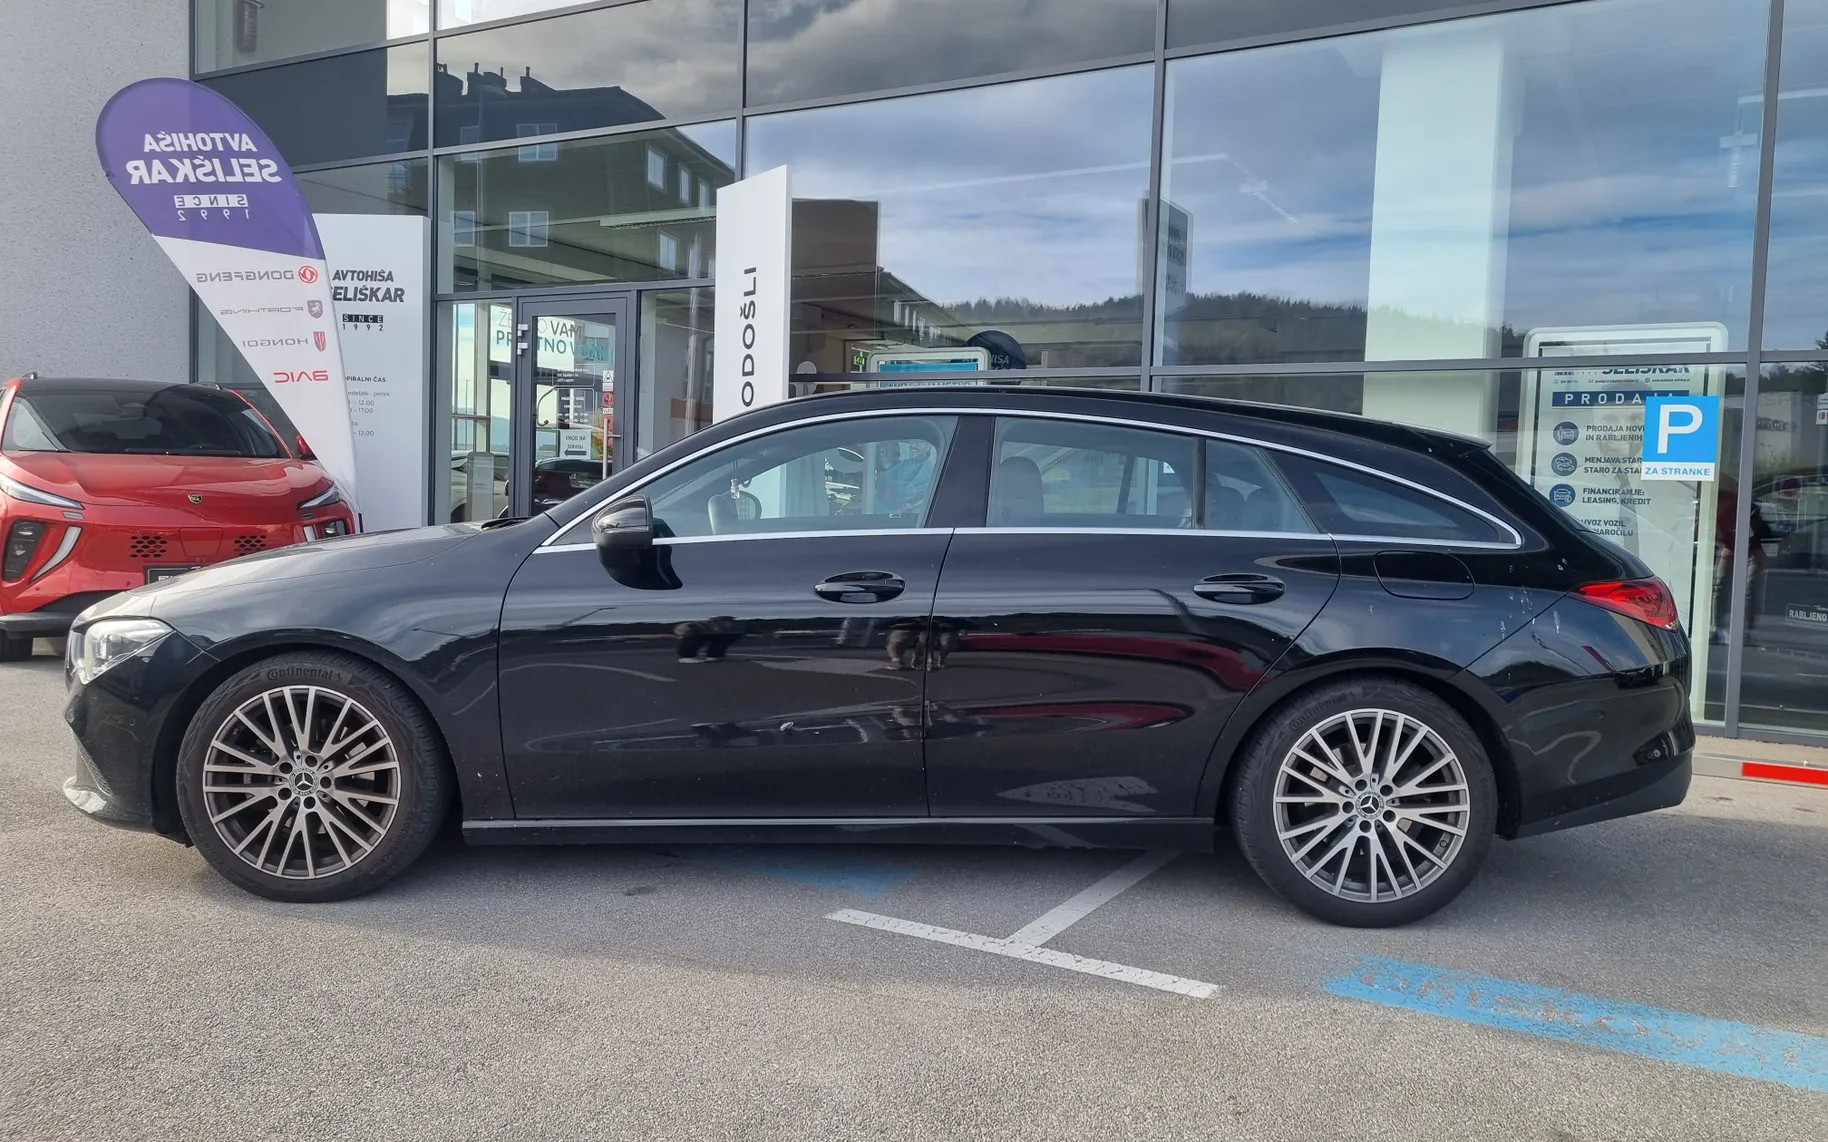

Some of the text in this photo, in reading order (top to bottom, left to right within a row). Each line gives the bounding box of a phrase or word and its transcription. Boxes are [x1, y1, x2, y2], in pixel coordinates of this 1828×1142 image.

[332, 269, 395, 283] AVTOHIŠA
[331, 285, 405, 303] ELIŠKAR
[342, 314, 383, 323] SINCE
[342, 323, 384, 332] 1992
[373, 375, 387, 383] ČAS
[1564, 392, 1675, 405] PRODA
[1657, 404, 1703, 454] P
[1596, 434, 1643, 442] RABLJENIH
[1584, 456, 1621, 464] MENJAVA
[1645, 467, 1711, 477] ZA STRANKE
[1582, 497, 1652, 506] LEASING, KREDIT
[1603, 519, 1626, 528] VOZIL
[1788, 609, 1828, 622] RABLJENO
[266, 665, 335, 681] Continental
